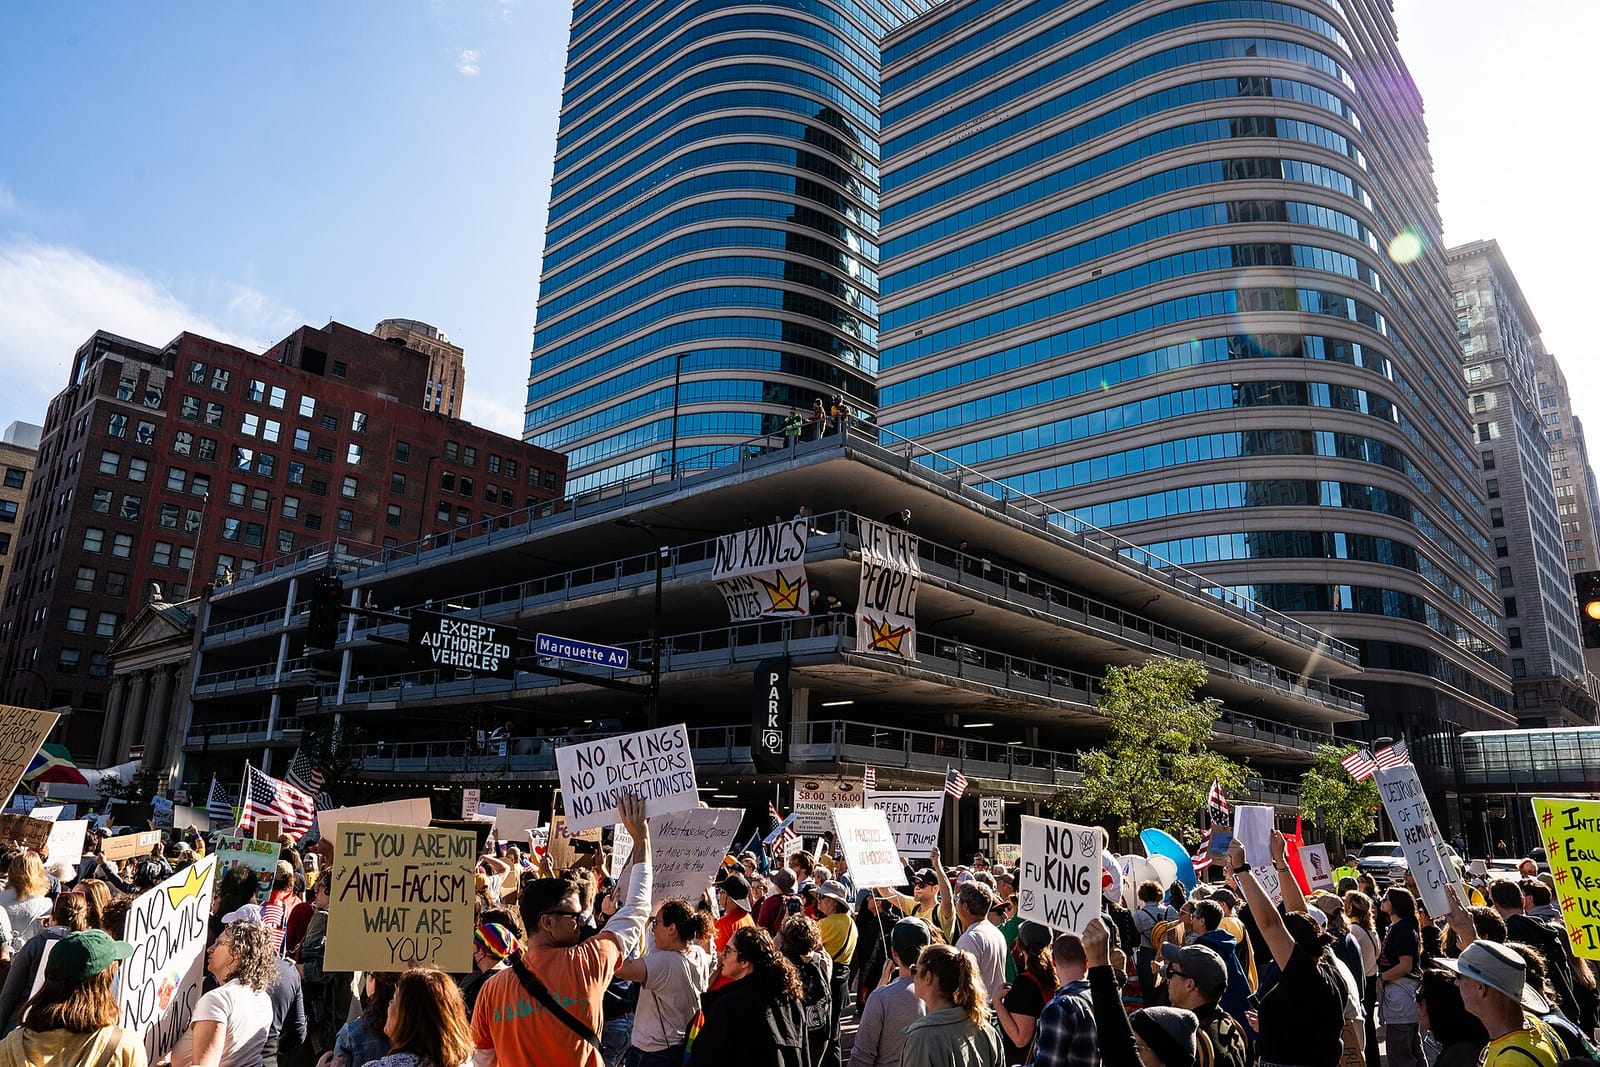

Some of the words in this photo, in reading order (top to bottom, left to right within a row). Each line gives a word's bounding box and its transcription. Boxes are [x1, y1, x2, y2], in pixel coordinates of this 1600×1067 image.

[713, 534, 738, 576] NO
[741, 520, 807, 567] KINGS
[716, 575, 755, 594] TWIN
[862, 560, 920, 619] PEOPLE
[727, 591, 762, 619] CITIES
[440, 618, 496, 642] EXCEPT
[421, 631, 511, 660] AUTHORIZED
[540, 638, 604, 662] Marquette
[608, 652, 625, 665] Av
[431, 648, 500, 672] VEHICLES
[768, 672, 780, 728] PARK
[576, 745, 606, 772] NO
[619, 729, 684, 762] KINGS
[570, 771, 595, 794] NO
[606, 752, 687, 785] DICTATORS
[572, 795, 593, 819] NO
[796, 803, 827, 811] PARKING
[799, 791, 825, 800] $8.00
[831, 793, 861, 802] $16.00
[873, 802, 910, 813] DEFEND
[916, 801, 936, 813] THE
[982, 800, 998, 809] ONE
[886, 813, 940, 824] STITUTION
[982, 808, 998, 817] WAY
[1398, 808, 1411, 822] OF
[216, 836, 244, 851] And
[344, 832, 366, 857] IF
[369, 832, 405, 859] YOU
[411, 832, 447, 858] ARE
[448, 835, 476, 859] NOT
[905, 833, 937, 845] TRUMP
[1045, 824, 1074, 860] NO
[1416, 848, 1431, 866] IS
[134, 888, 165, 942] NO
[363, 907, 411, 934] WHAT
[415, 907, 453, 935] ARE
[1043, 893, 1084, 933] WAY
[128, 893, 207, 992] CROWNS
[385, 936, 443, 965] YOU?
[123, 977, 156, 1032] NO
[143, 983, 197, 1067] OWNS
